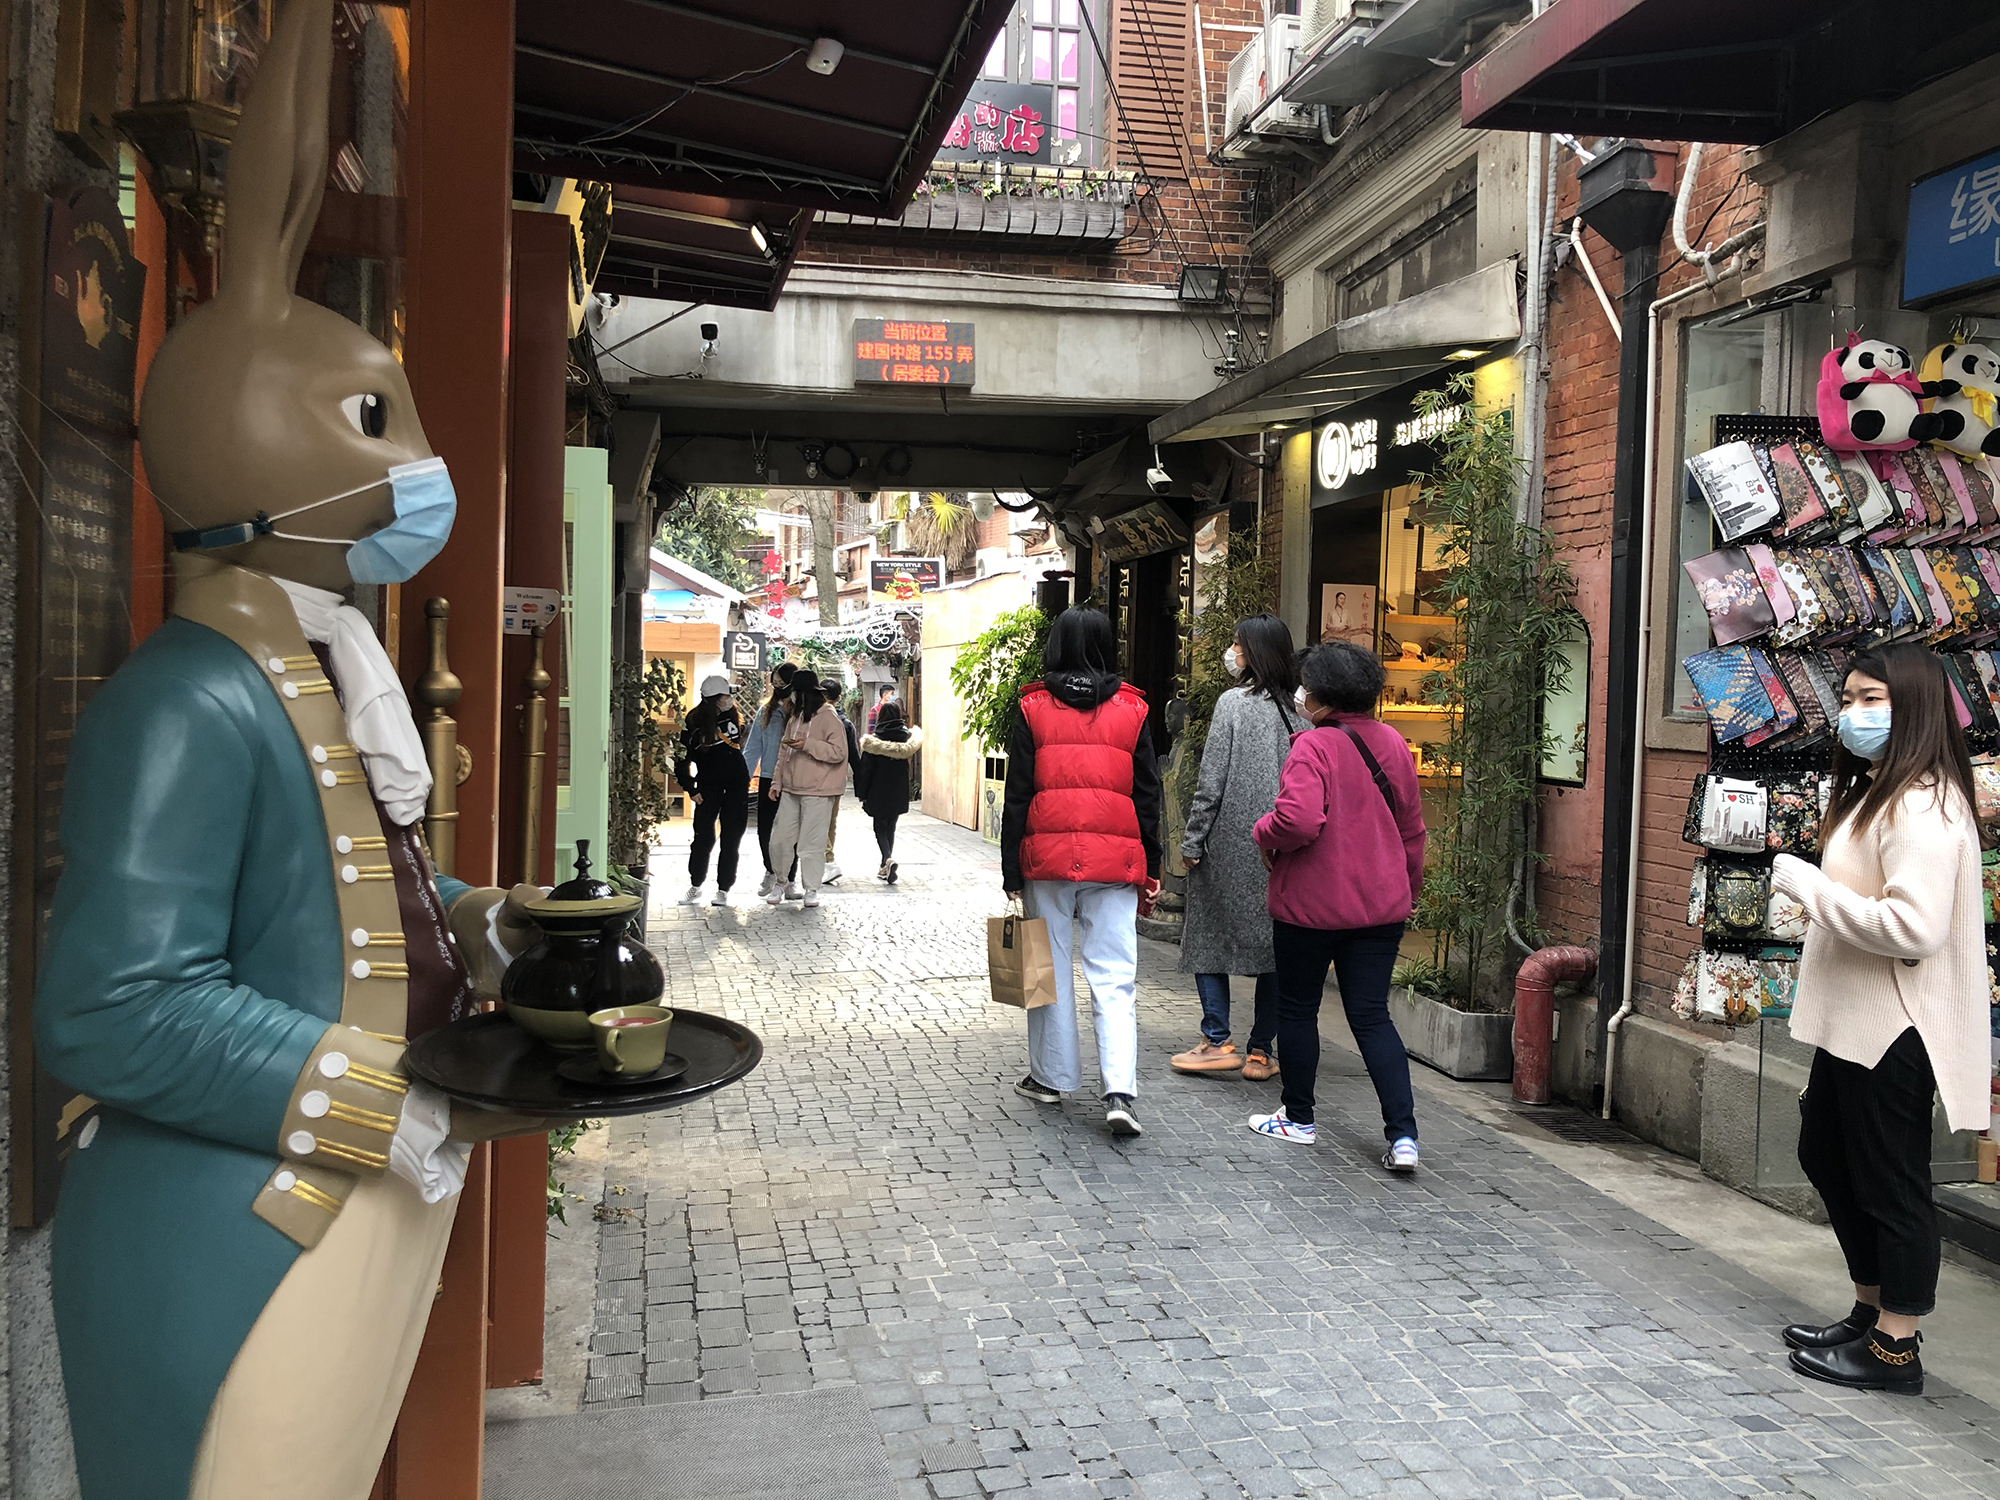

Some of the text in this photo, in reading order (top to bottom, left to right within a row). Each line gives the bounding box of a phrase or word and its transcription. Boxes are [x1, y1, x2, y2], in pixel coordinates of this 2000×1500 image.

[975, 130, 996, 144] BIG
[978, 141, 1001, 154] PINK
[884, 322, 948, 342] 当前位置
[857, 341, 974, 364] 建国中路 155 弄
[1739, 794, 1754, 805] SH
